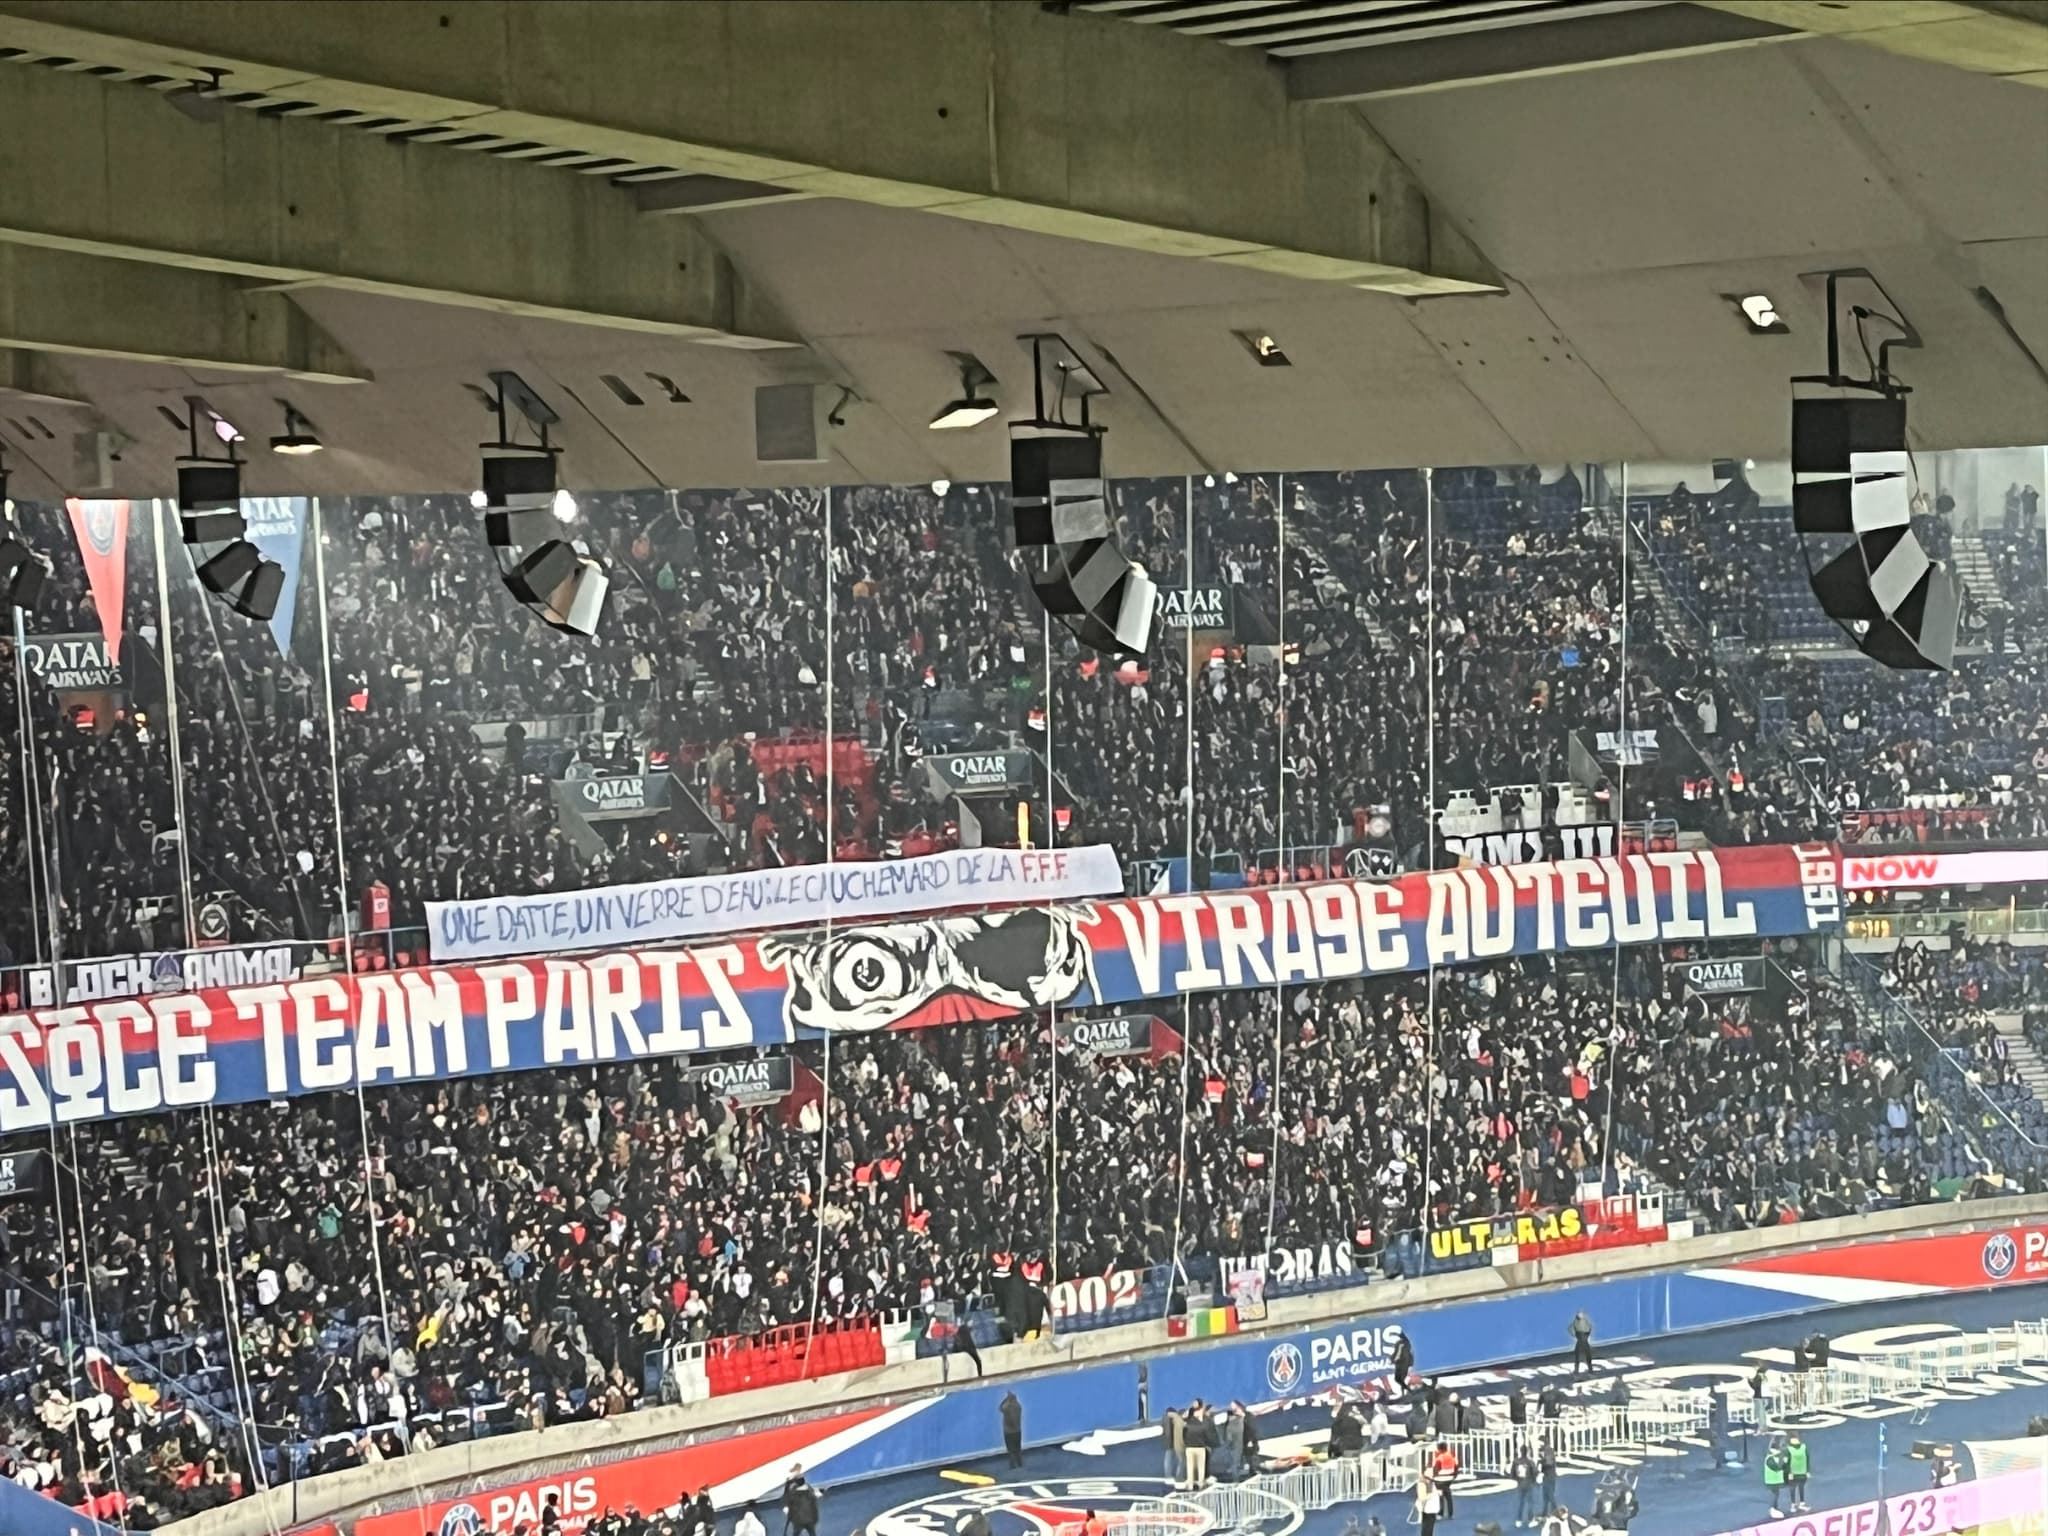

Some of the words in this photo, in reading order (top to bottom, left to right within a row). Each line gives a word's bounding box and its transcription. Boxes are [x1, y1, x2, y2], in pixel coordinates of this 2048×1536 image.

[950, 756, 1006, 778] QATAR
[583, 778, 645, 802] QATAR
[1851, 859, 1938, 882] NOW
[441, 904, 490, 947] UNE
[616, 886, 695, 929] VERRE
[958, 853, 984, 885] DE
[988, 853, 1015, 882] LA
[184, 947, 299, 991] ANIMAL
[228, 969, 467, 1093] TEAM
[480, 943, 753, 1068] PARIS
[1110, 881, 1410, 994] VIRAGE
[1426, 850, 1757, 965] AUTEUIL
[1689, 963, 1743, 984] QATAR
[1074, 1021, 1130, 1045] QATAR
[708, 1063, 769, 1089] QATAR
[1311, 1325, 1403, 1368] PARIS
[490, 1477, 597, 1533] PARIS
[1900, 1495, 1937, 1536] 23
